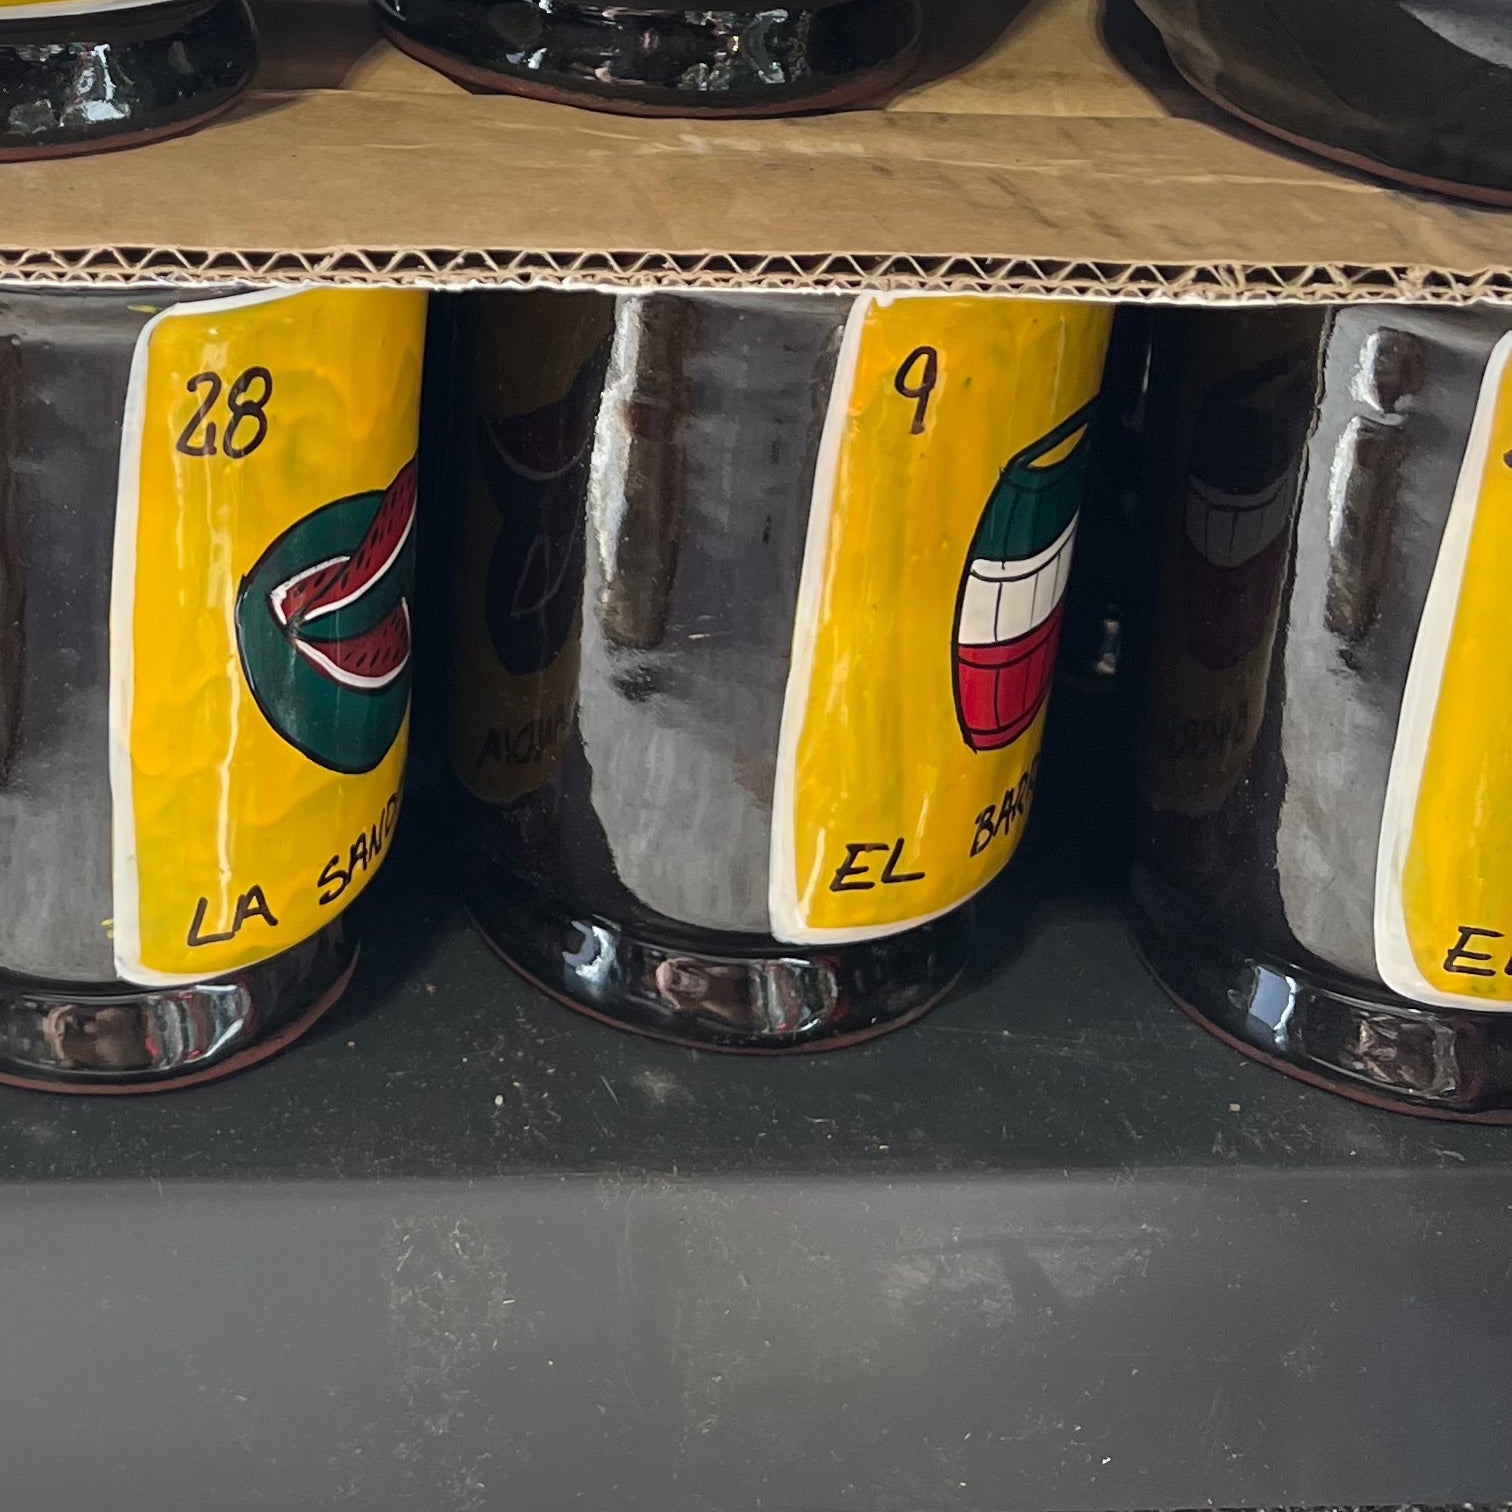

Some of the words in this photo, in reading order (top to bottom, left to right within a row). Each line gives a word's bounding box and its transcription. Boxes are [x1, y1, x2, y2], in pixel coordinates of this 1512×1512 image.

[175, 365, 273, 459] 28
[894, 345, 938, 435] 9
[187, 884, 278, 947] LA
[317, 792, 399, 906] SAND
[829, 837, 925, 892] EL
[969, 754, 1037, 858] BAR
[1441, 924, 1512, 977] E
